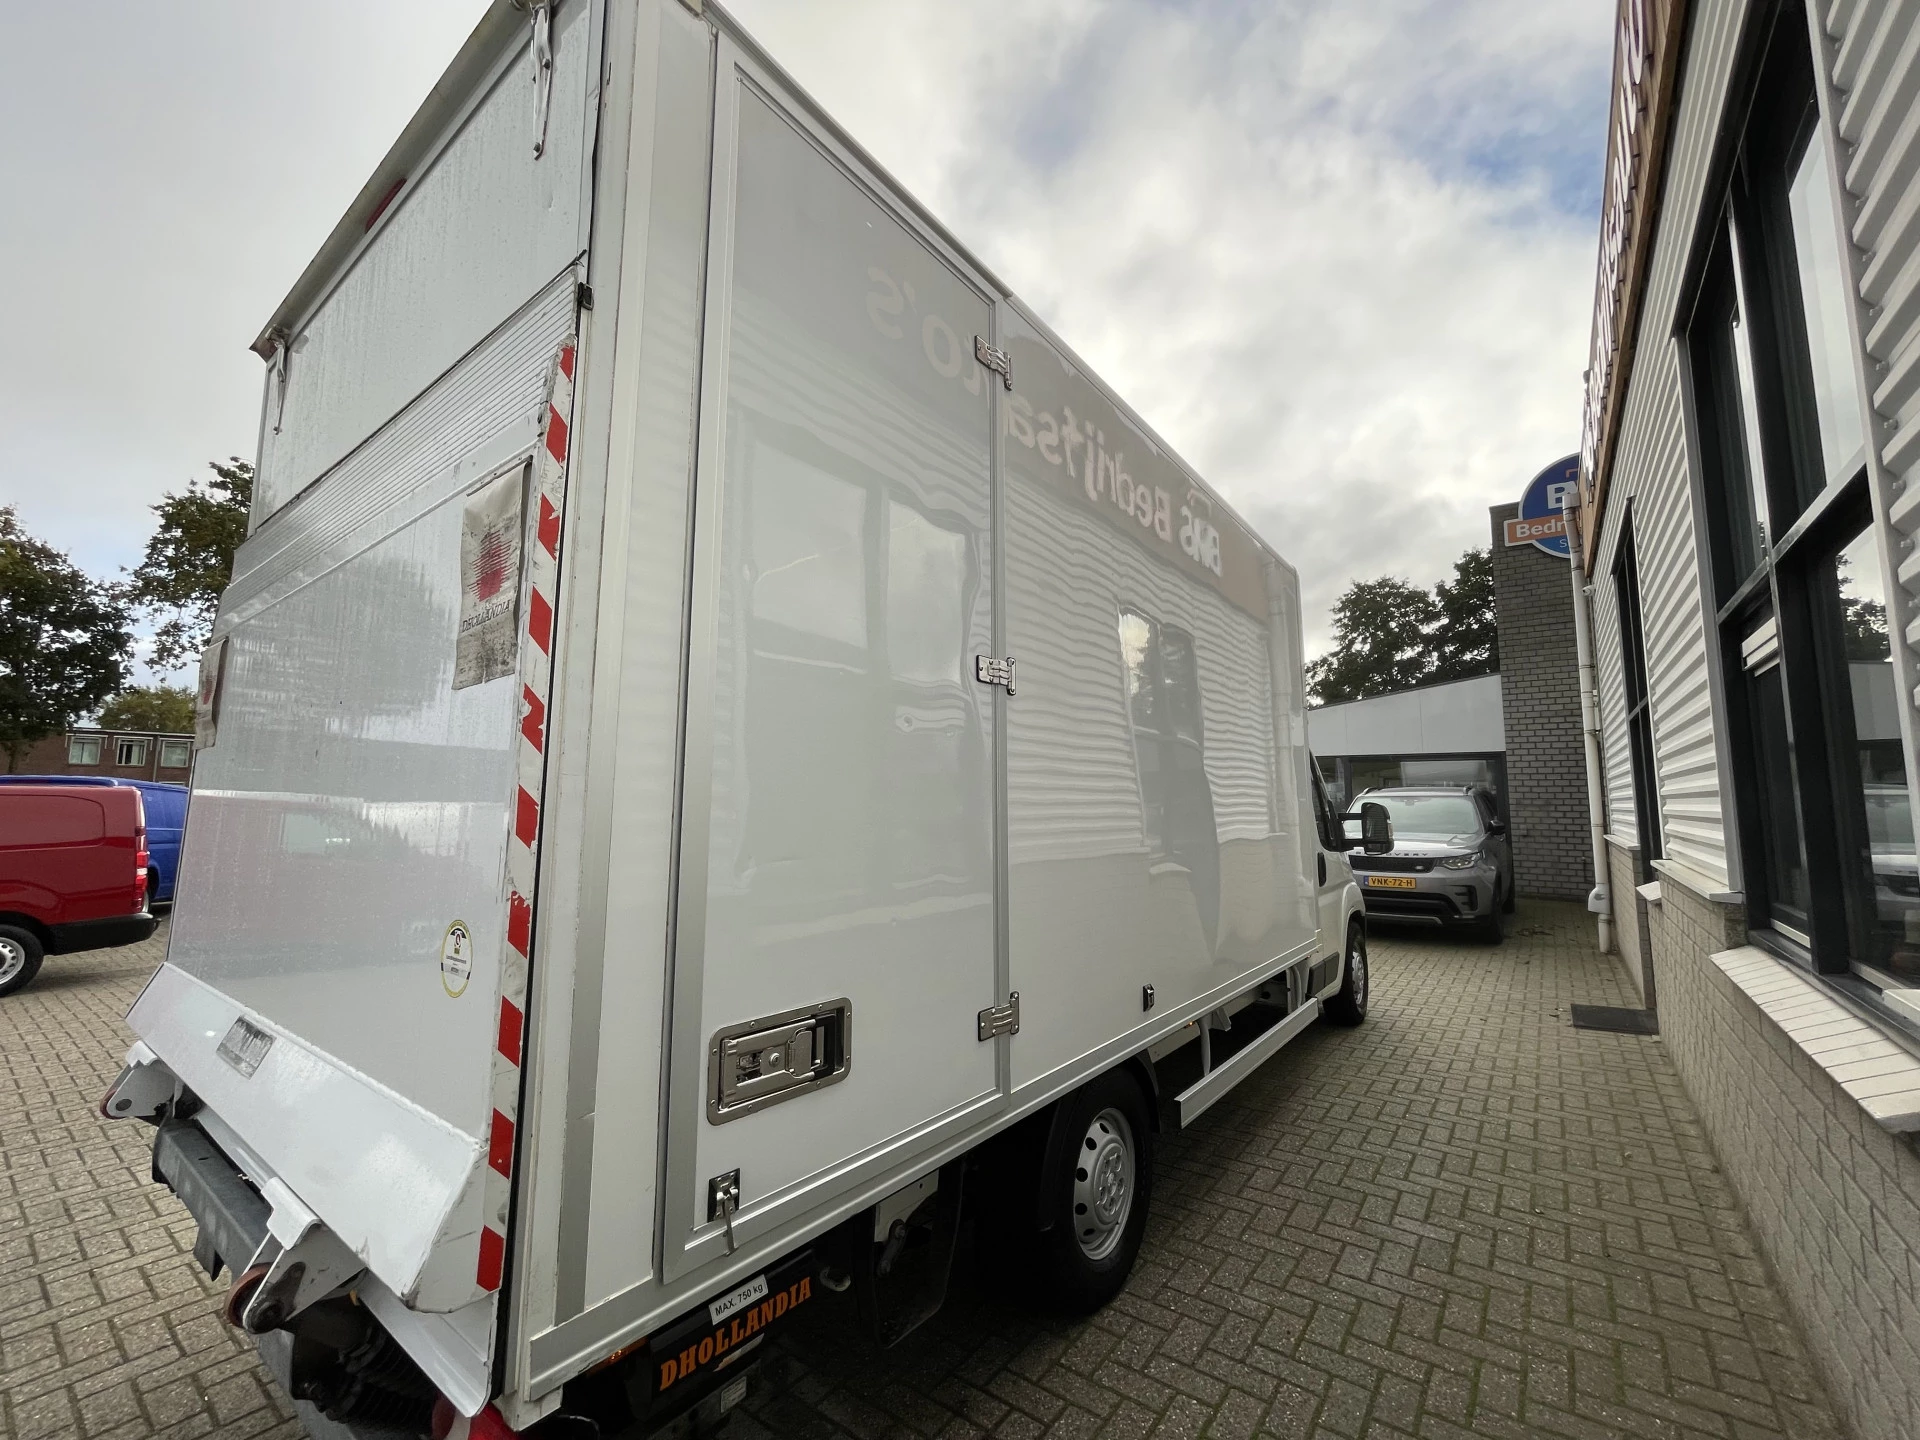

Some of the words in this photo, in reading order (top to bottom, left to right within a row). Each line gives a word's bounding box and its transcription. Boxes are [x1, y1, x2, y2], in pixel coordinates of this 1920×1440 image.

[1370, 877, 1413, 887] VNK-72-H
[715, 1298, 736, 1316] MAX.
[737, 1289, 752, 1303] 750
[752, 1282, 764, 1295] kg
[660, 1276, 812, 1391] DHOLLANDIA
